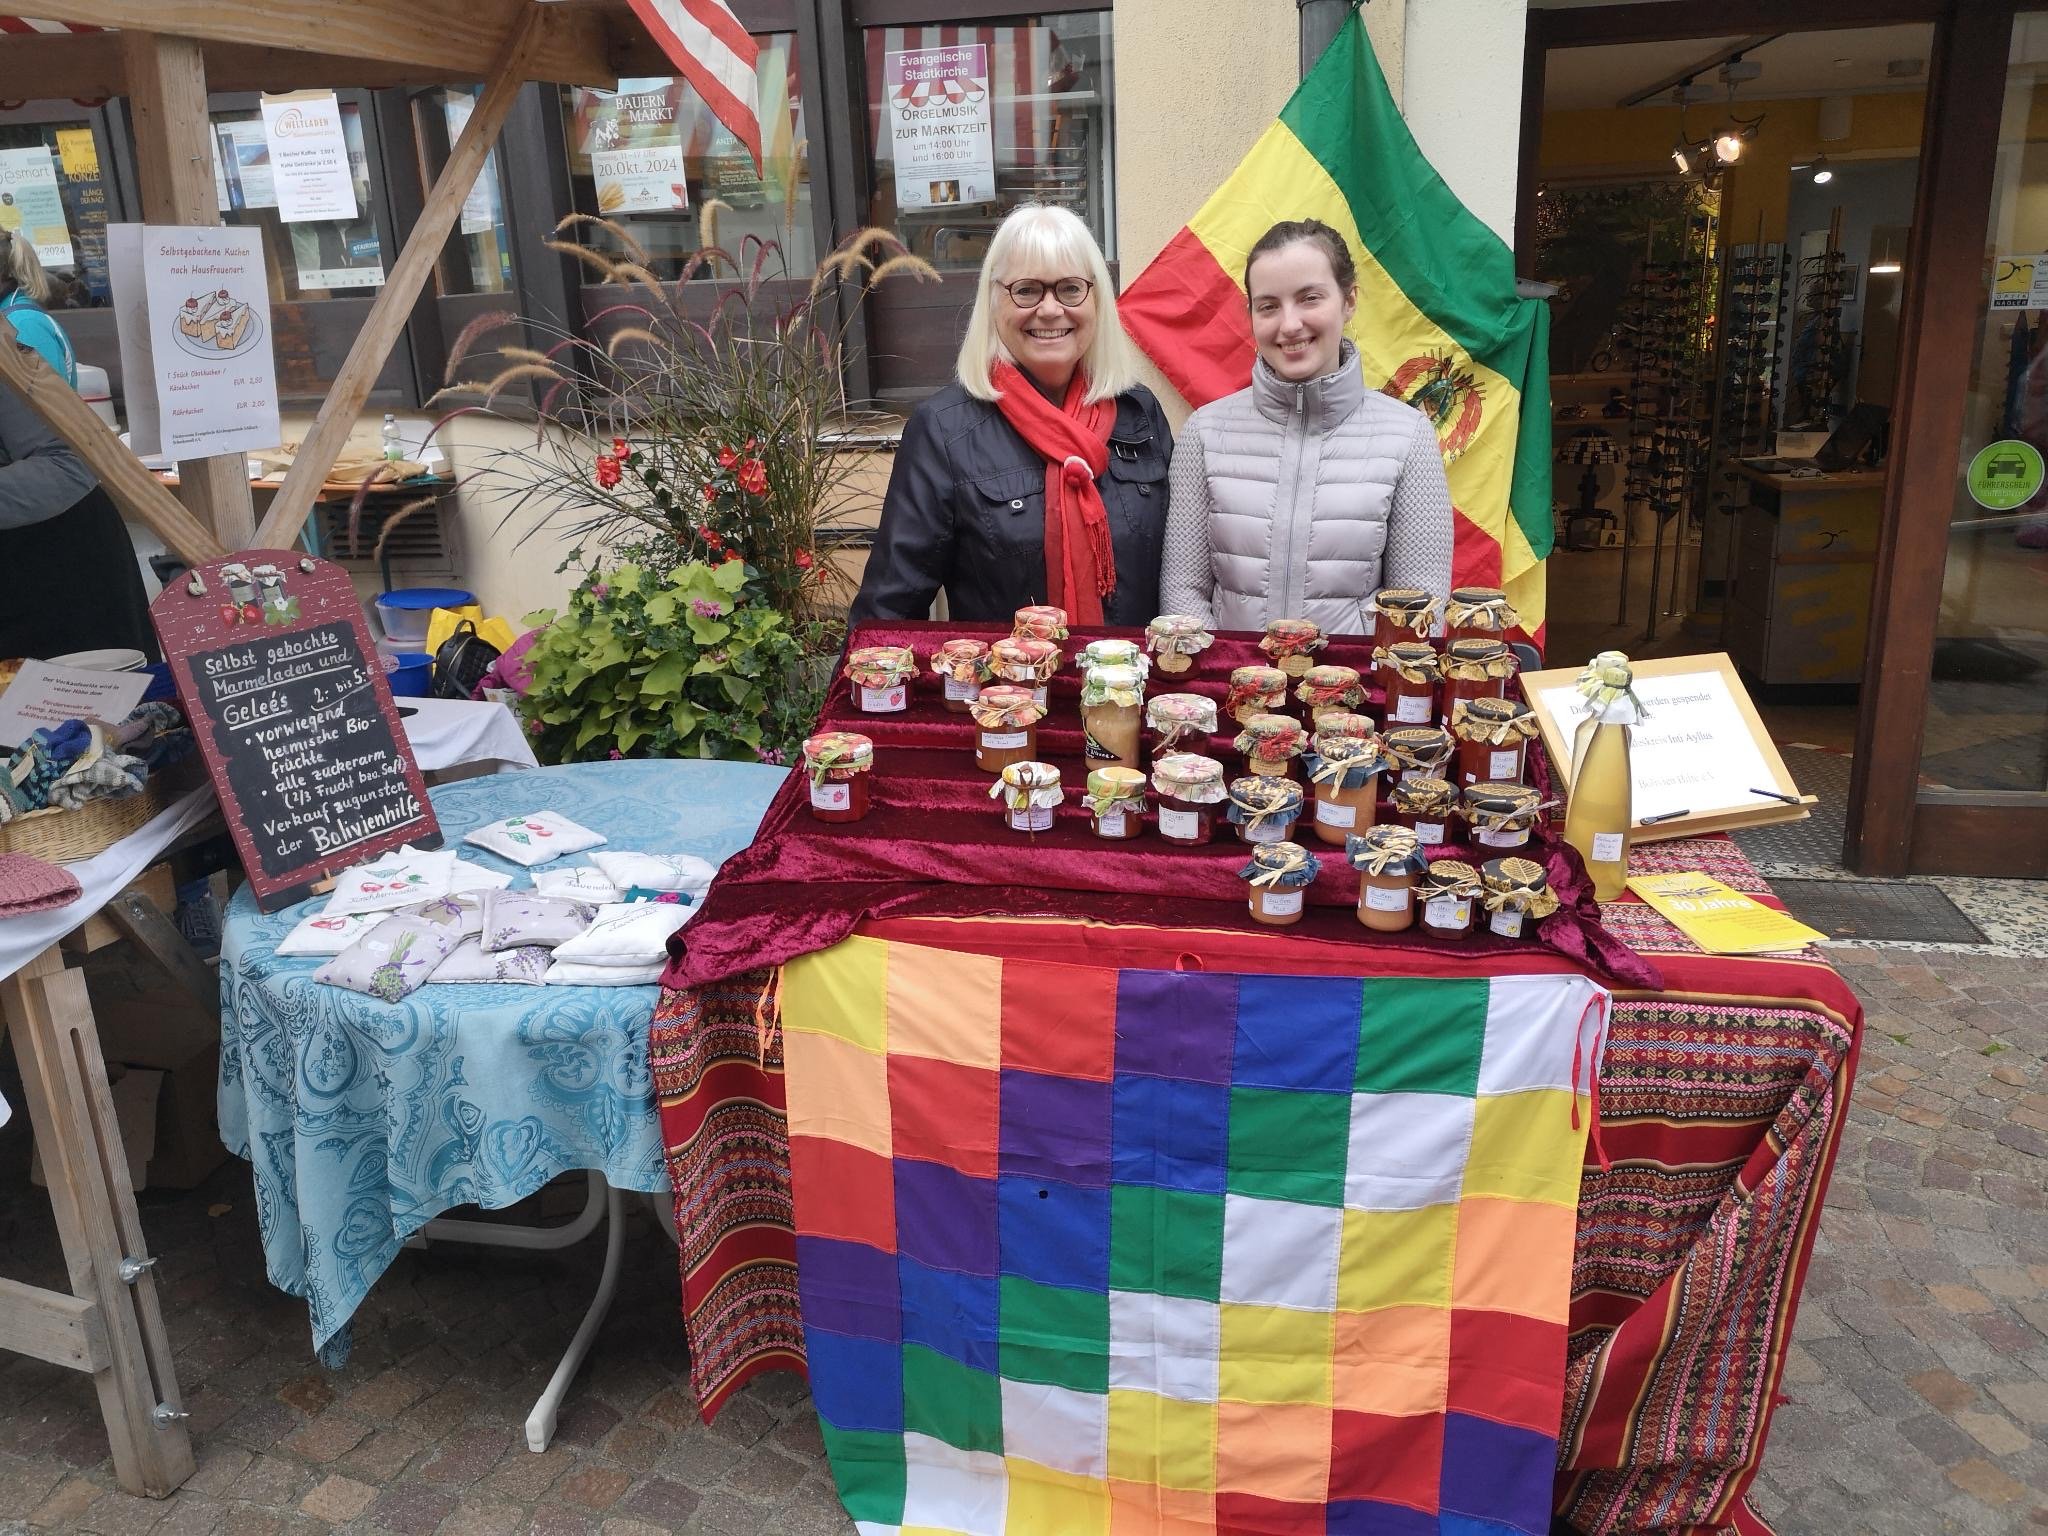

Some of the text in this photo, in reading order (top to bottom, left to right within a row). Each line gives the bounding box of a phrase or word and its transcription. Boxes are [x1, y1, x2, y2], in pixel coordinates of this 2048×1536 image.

[899, 51, 973, 67] Evangelische
[905, 65, 969, 81] Stadtkirche
[615, 95, 666, 110] BAUERN
[629, 107, 674, 122] MARKT
[901, 105, 979, 121] ORGELMUSIK
[284, 118, 329, 130] WELTLADEN
[921, 122, 988, 138] MARKTZEIT
[929, 140, 953, 150] 14:00
[954, 139, 972, 148] Uhr
[912, 150, 974, 163] und 16:00 Uhr
[646, 158, 678, 174] 2024
[160, 245, 250, 258] Selbstgebackene Kuchen
[170, 264, 245, 275] nach Hausfrauenart
[173, 371, 188, 379] Stück
[190, 369, 221, 378] Obstkuchen
[169, 383, 200, 392] Käsekuchen
[233, 378, 245, 386] EUR
[236, 401, 248, 410] EUR
[205, 631, 339, 676] Selbst gekochte
[212, 648, 353, 697] Marmeladen und
[223, 690, 289, 725] Geleés
[336, 679, 352, 693] bis
[1671, 692, 1713, 708] gespendet
[255, 701, 346, 744] vorwiegend
[262, 717, 377, 761] heimische Bio-
[1685, 731, 1714, 746] Ayllus
[270, 752, 326, 780] früchte
[275, 750, 387, 793] alle zuckerarm
[315, 776, 354, 798] Frucht
[263, 780, 409, 837] Verkauf zugunsten
[277, 794, 421, 857] der Bolivienhilfe
[1670, 898, 1754, 913] 30 Jahre
